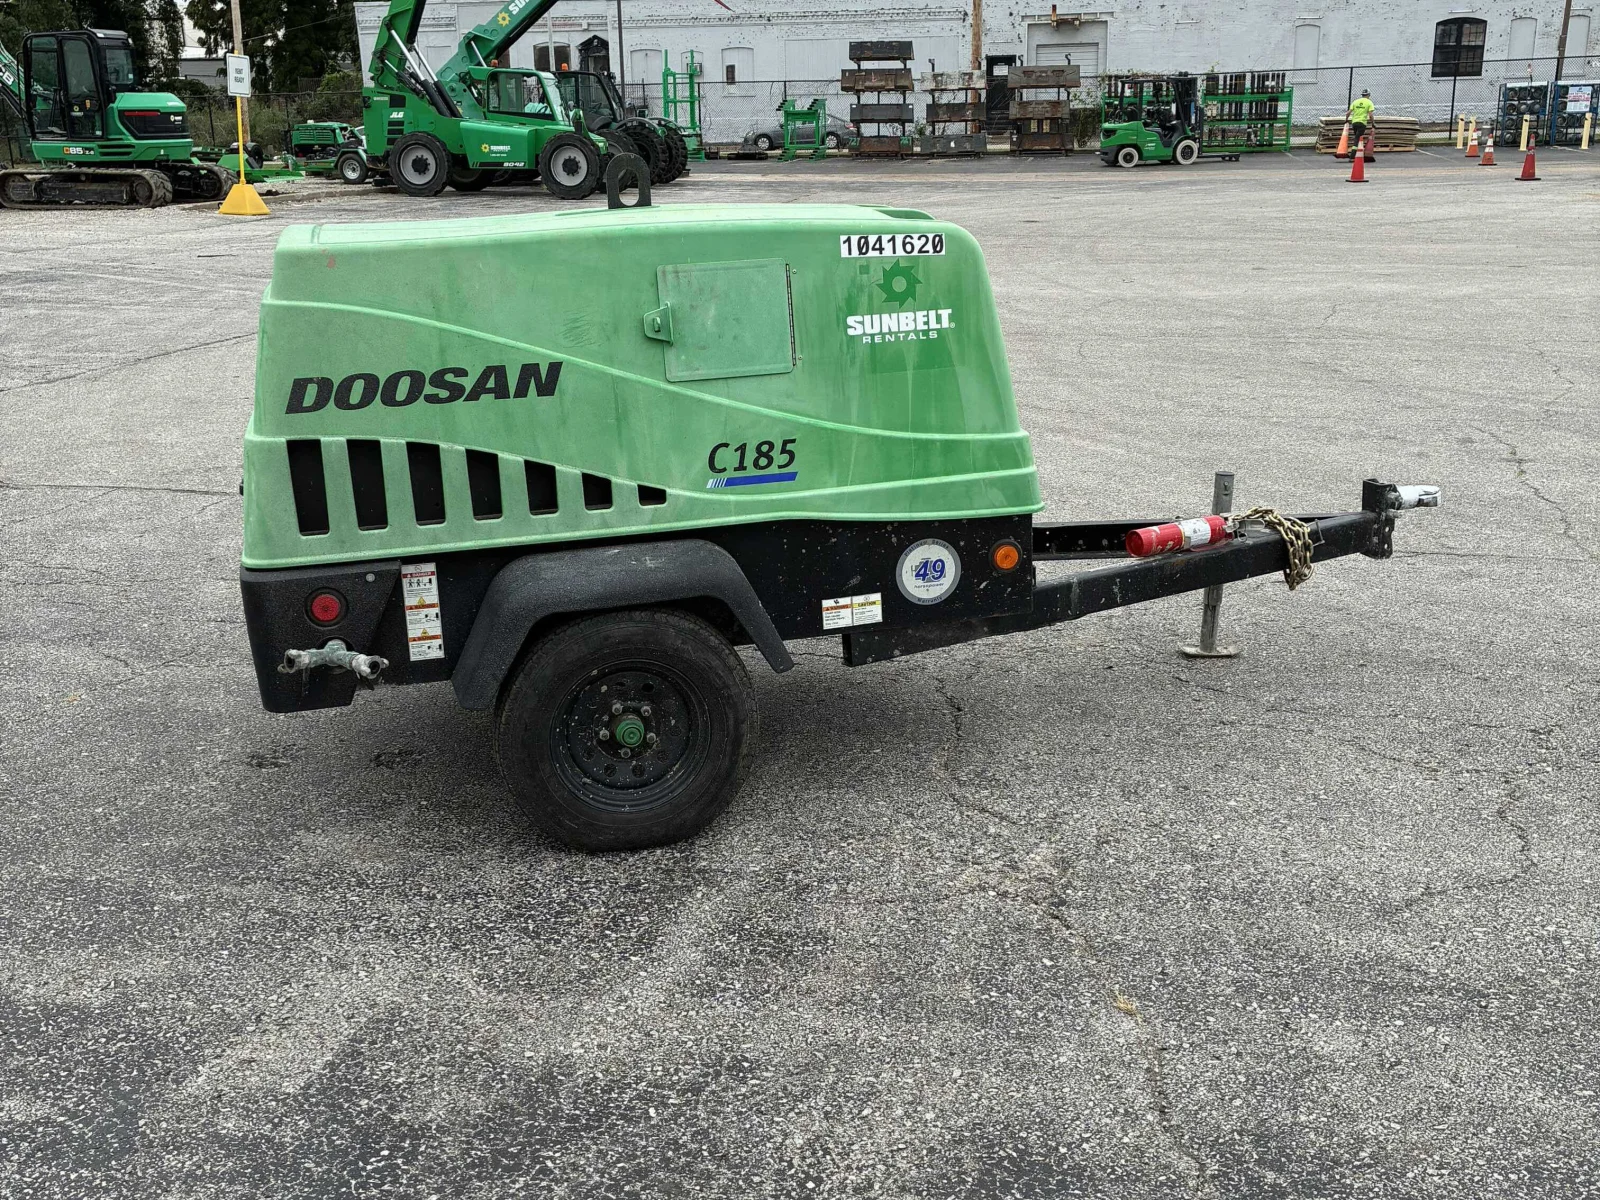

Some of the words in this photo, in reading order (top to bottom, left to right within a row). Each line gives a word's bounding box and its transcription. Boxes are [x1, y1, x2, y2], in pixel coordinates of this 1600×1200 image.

[234, 76, 245, 84] READY
[842, 233, 944, 256] 1041620
[846, 309, 953, 336] SUNBELT
[862, 331, 938, 344] RENTALS
[285, 361, 563, 415] DOOSAN
[707, 438, 797, 474] C185
[914, 558, 946, 582] 49
